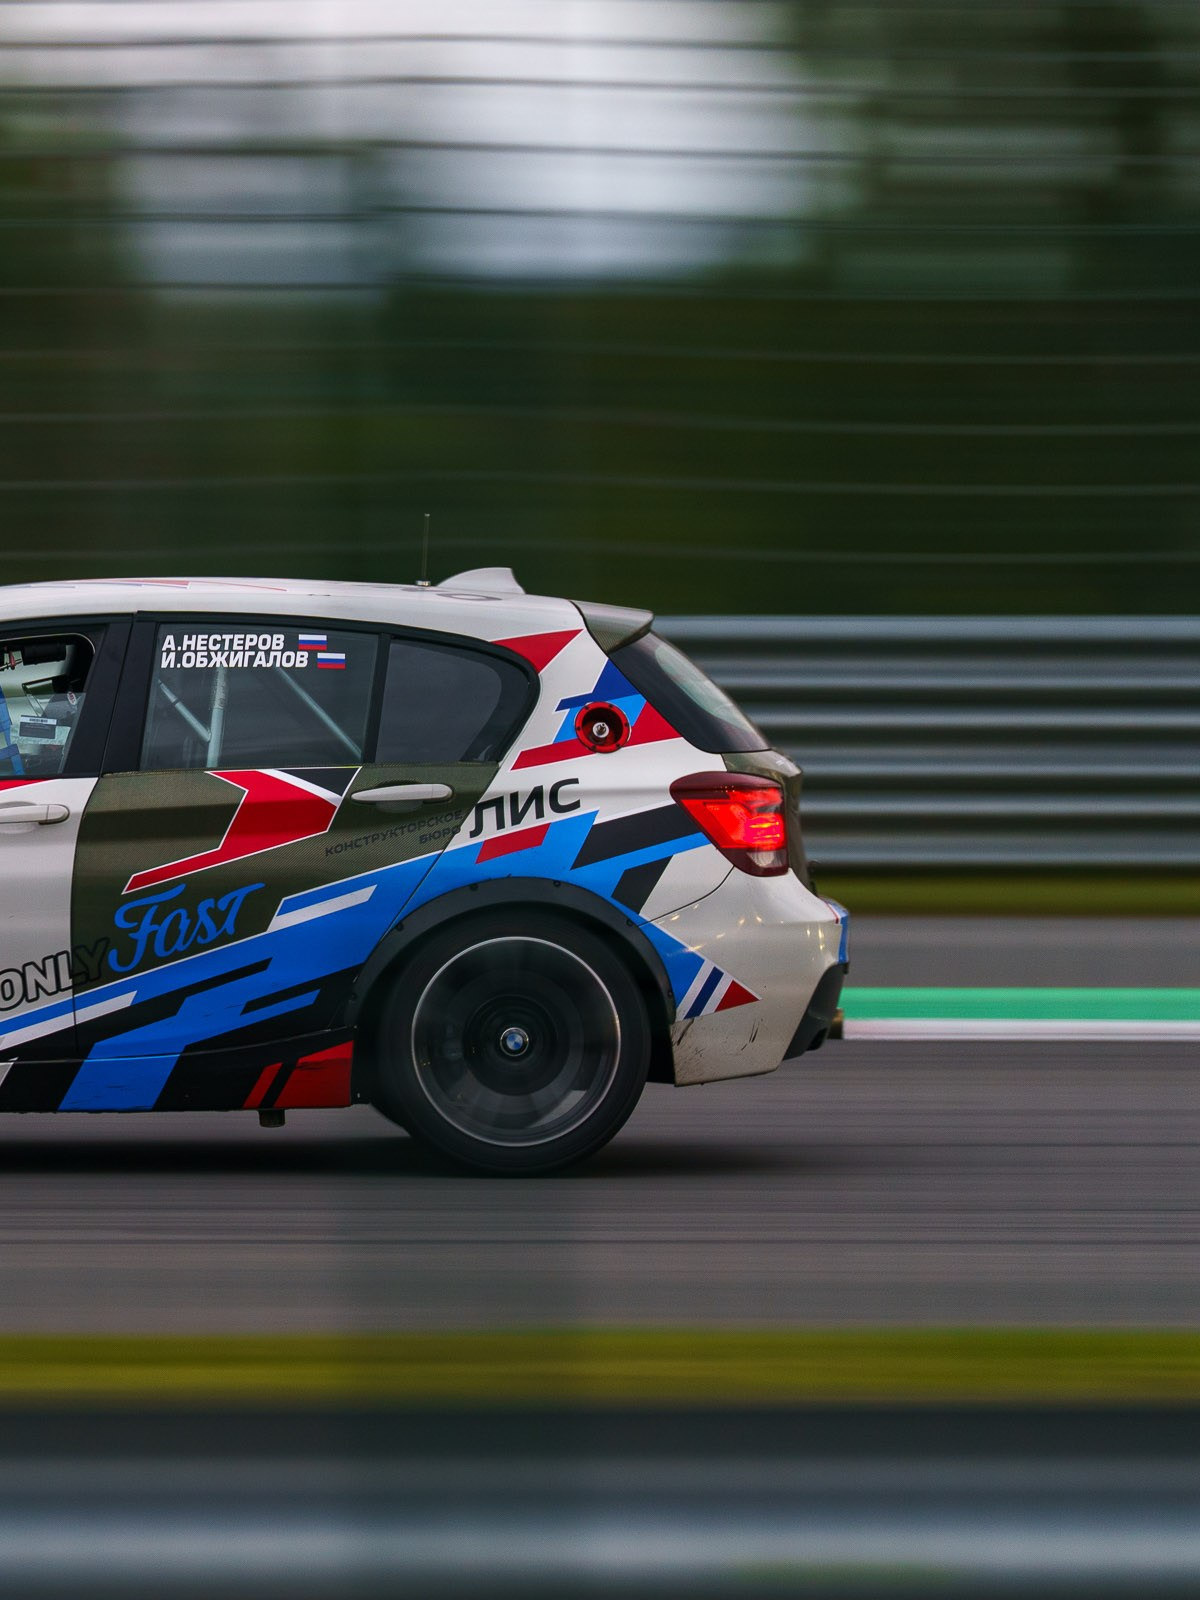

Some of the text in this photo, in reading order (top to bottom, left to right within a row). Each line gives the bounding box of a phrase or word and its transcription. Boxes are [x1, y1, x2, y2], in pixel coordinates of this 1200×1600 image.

[161, 633, 285, 651] А.НЕСТЕРОВ
[160, 651, 309, 668] И.ОБЖИГАЛОВ
[469, 778, 580, 838] ЛИС
[325, 809, 463, 857] КОНСТРУКТОРСКОЕ
[419, 824, 462, 844] БЮРО
